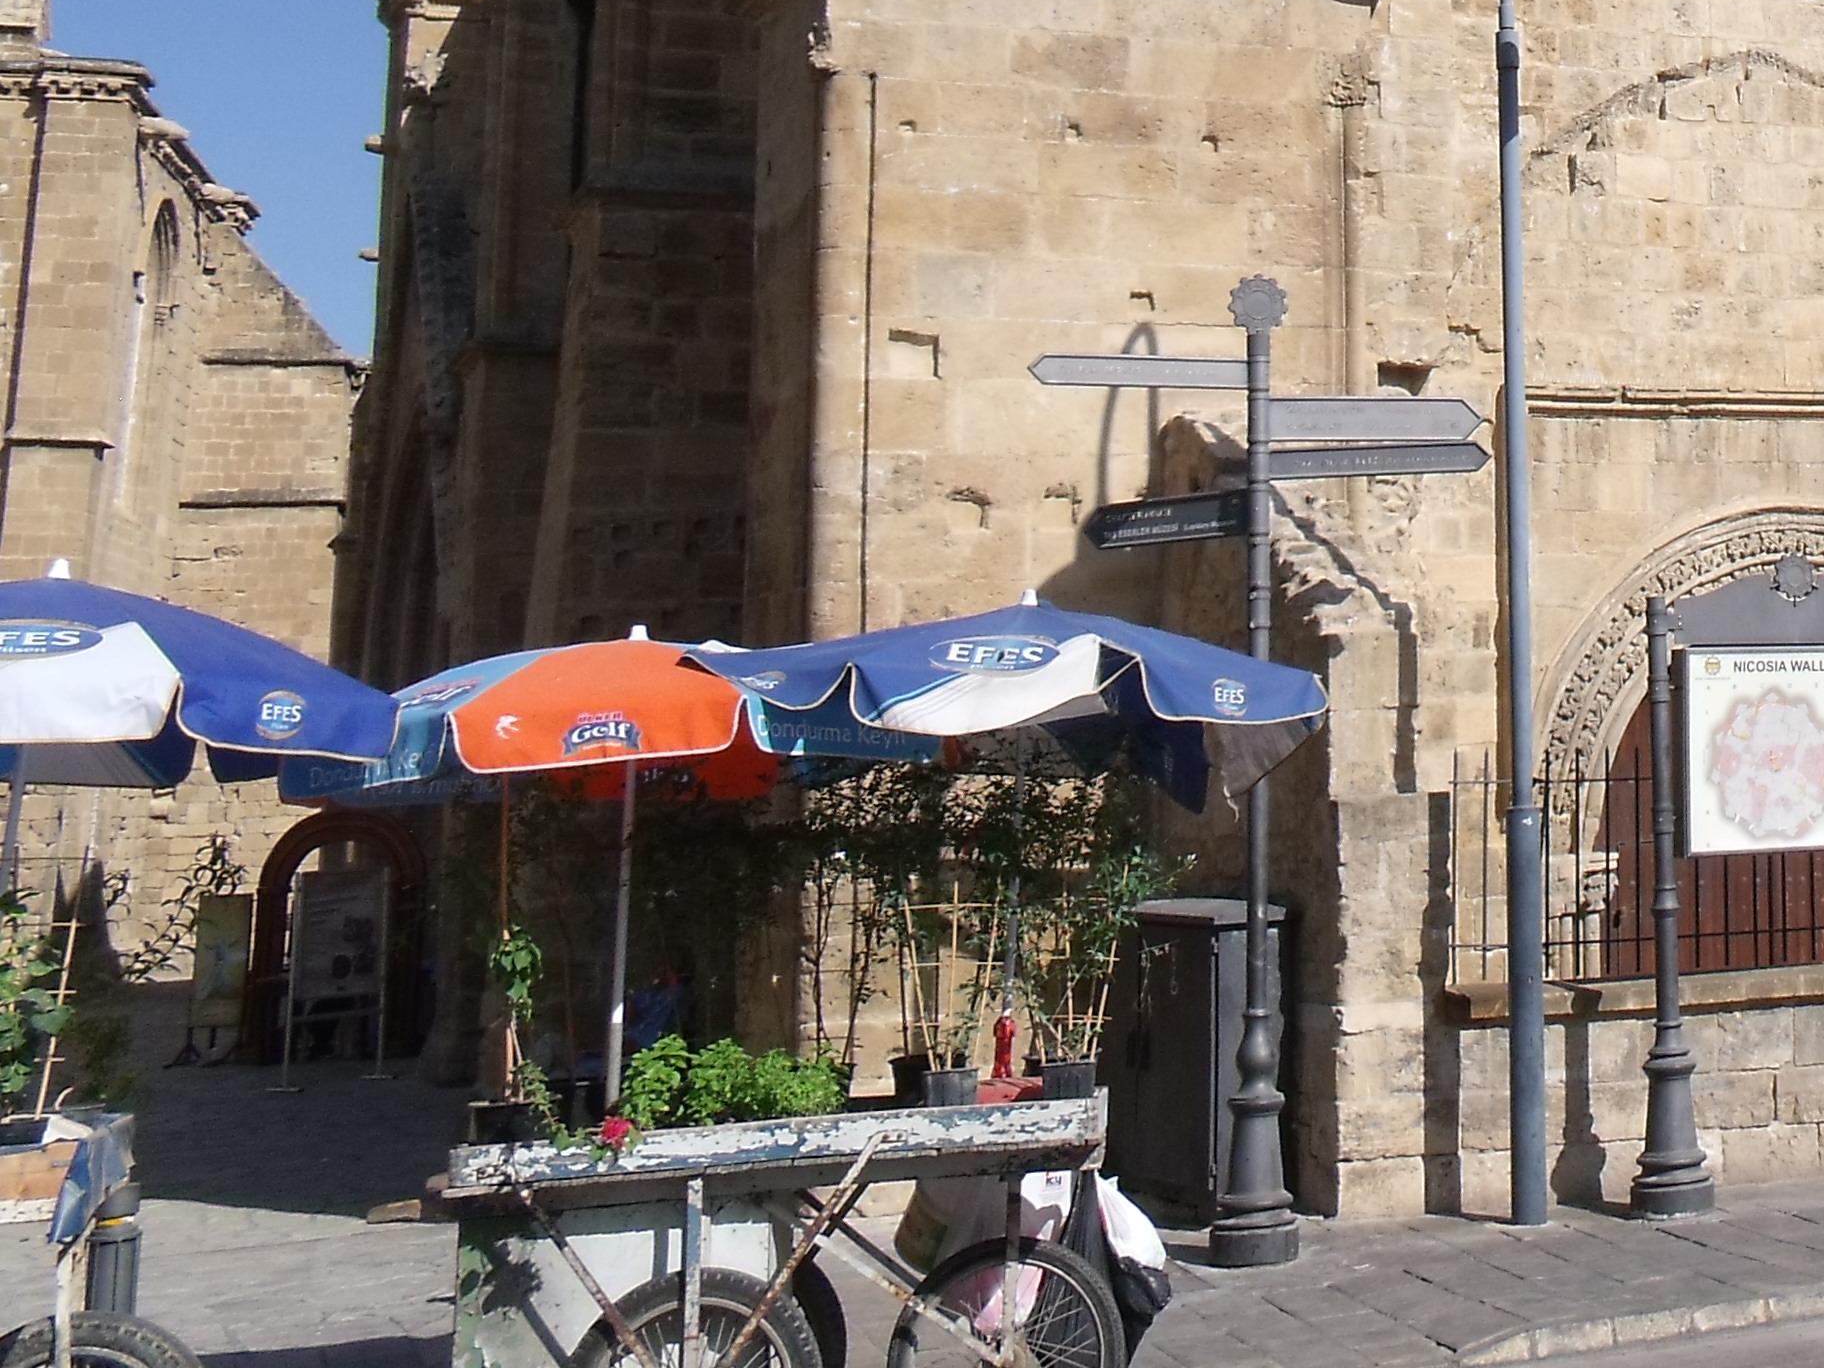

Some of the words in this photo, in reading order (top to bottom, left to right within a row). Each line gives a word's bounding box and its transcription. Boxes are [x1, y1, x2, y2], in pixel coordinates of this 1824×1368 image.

[946, 642, 1044, 664] EFES
[1733, 660, 1788, 673] NICOSIA
[1214, 686, 1245, 705] EFES
[261, 703, 302, 723] EFES
[571, 721, 630, 744] Golf
[758, 715, 853, 743] Dondurma
